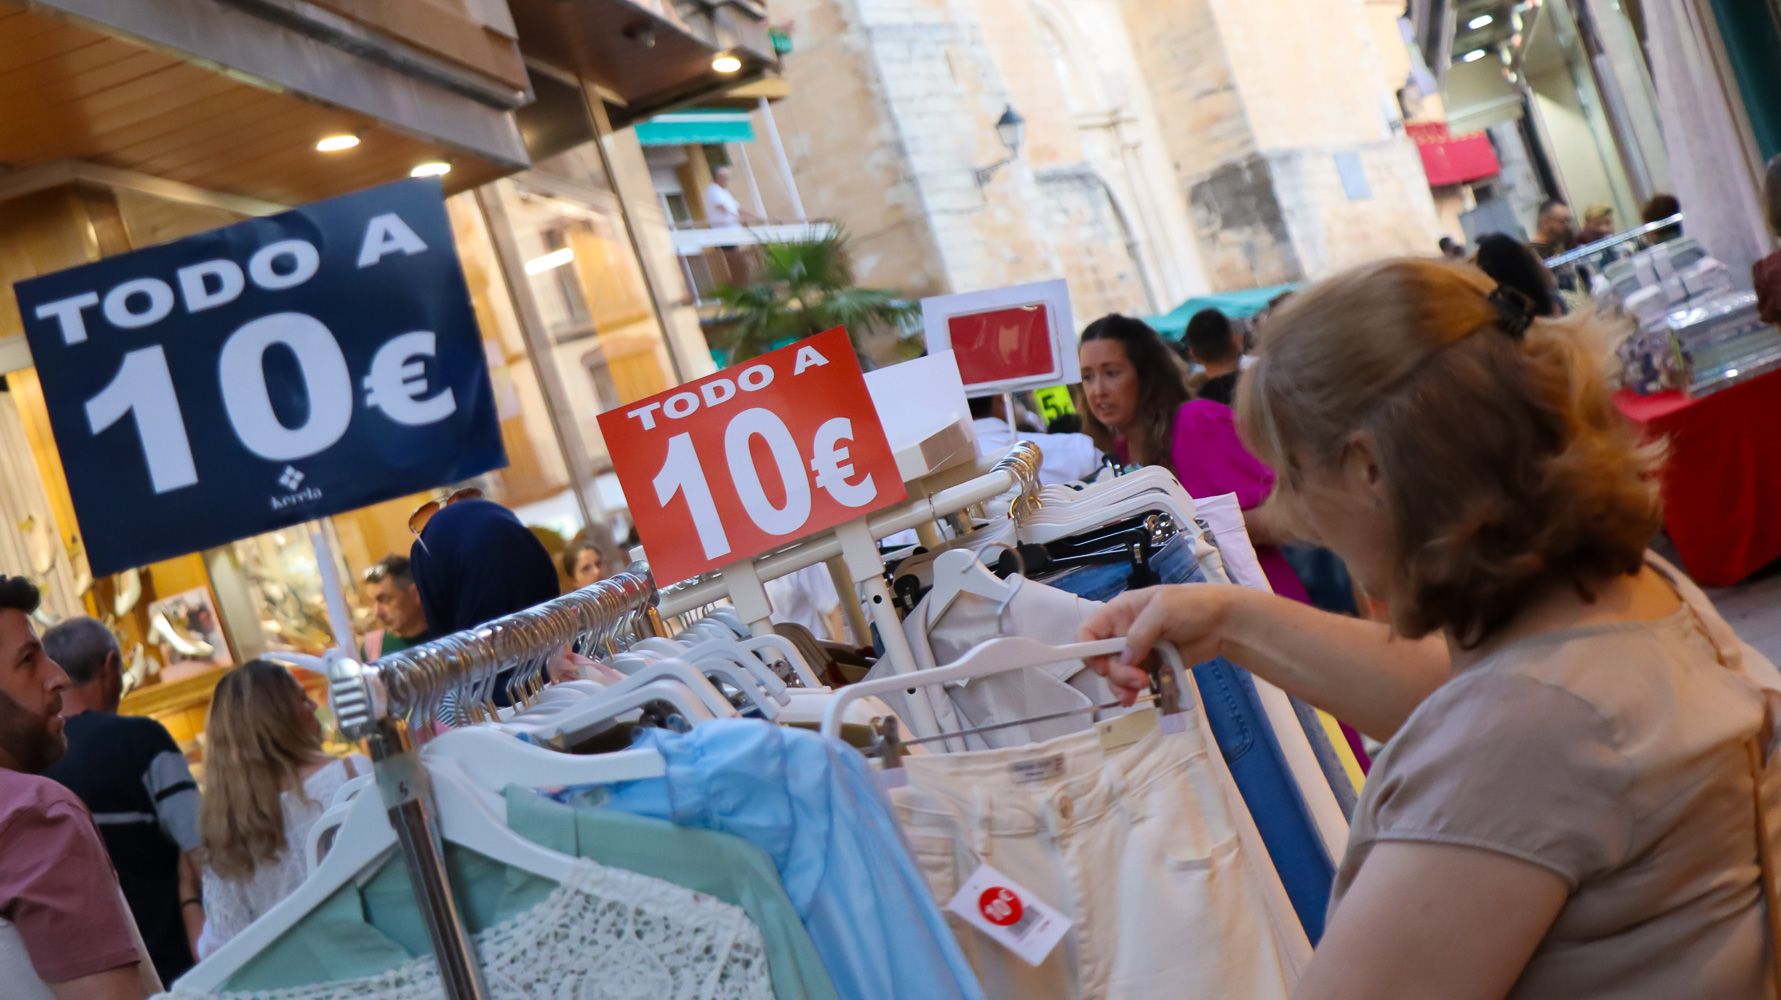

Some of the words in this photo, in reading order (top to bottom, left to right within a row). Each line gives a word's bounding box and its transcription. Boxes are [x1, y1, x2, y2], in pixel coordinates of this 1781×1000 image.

[36, 239, 320, 345] TODO
[357, 212, 428, 269] A
[85, 312, 457, 495] 10€
[626, 364, 775, 431] TODO
[793, 345, 830, 376] A
[652, 407, 878, 561] 10€
